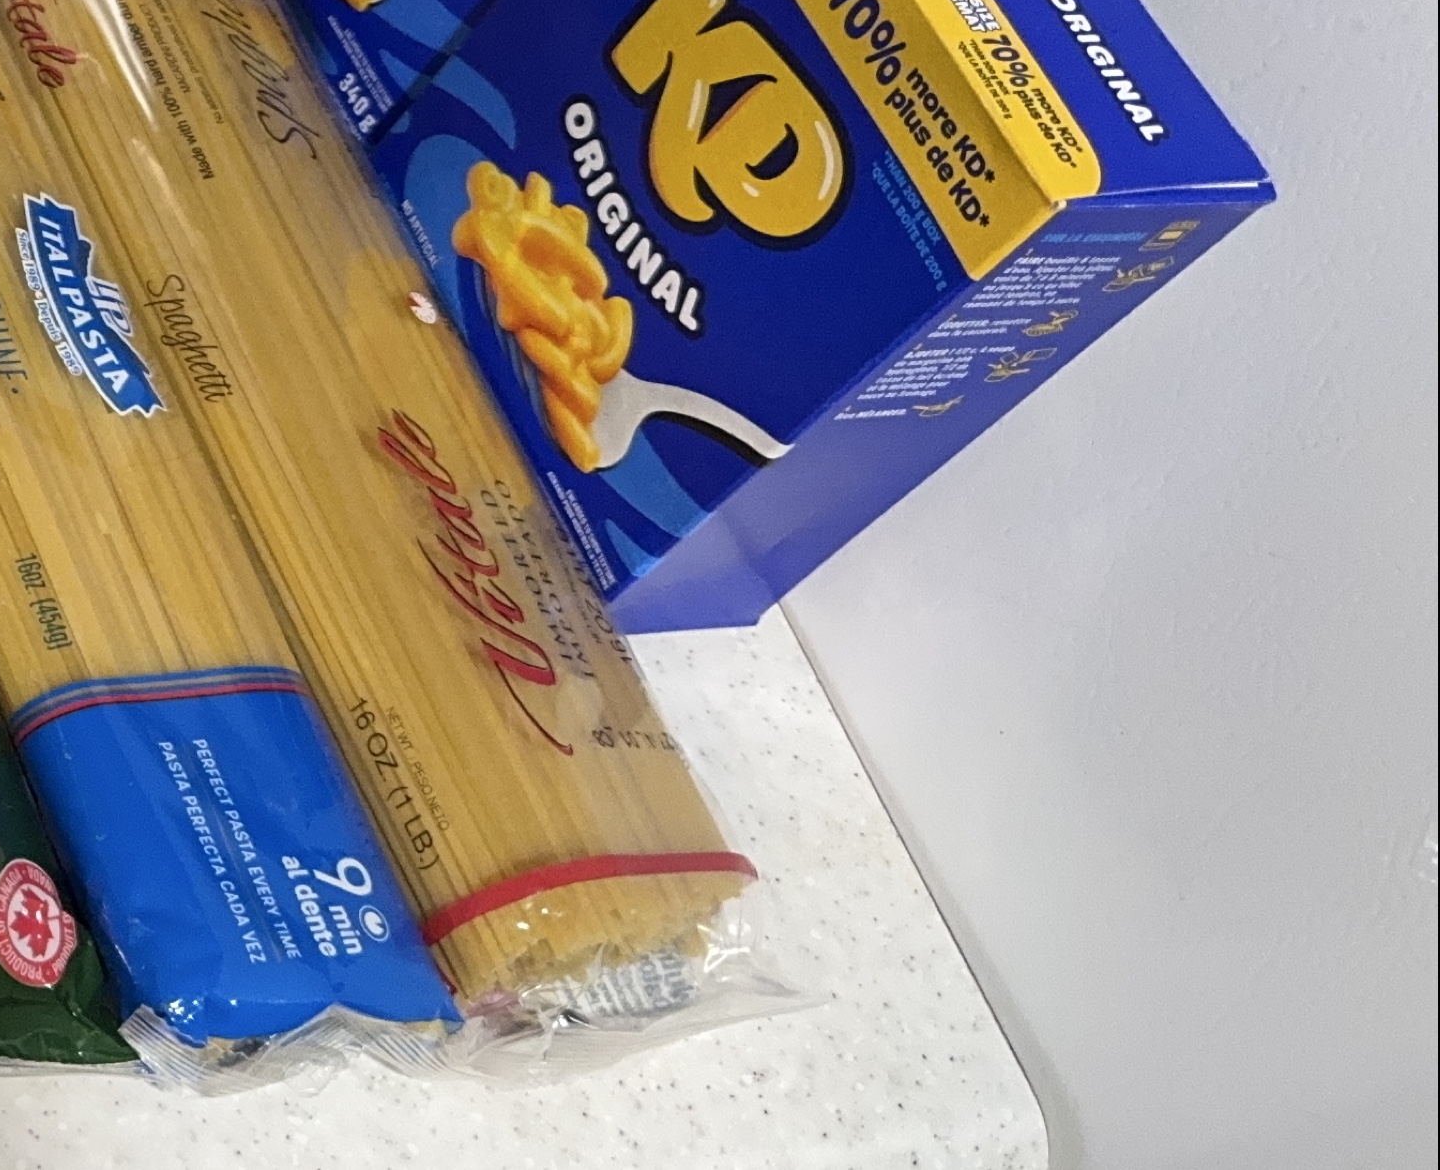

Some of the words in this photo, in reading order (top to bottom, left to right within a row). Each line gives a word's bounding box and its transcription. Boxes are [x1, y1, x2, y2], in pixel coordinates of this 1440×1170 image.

[124, 19, 153, 59] amber
[982, 34, 1035, 88] 70%
[143, 56, 168, 87] hard
[339, 72, 370, 116] 340
[157, 85, 184, 120] 100%
[906, 67, 958, 140] more
[1030, 87, 1061, 126] more
[175, 118, 197, 145] with
[884, 87, 932, 147] plus
[926, 145, 955, 183] de
[188, 142, 216, 181] Made
[564, 100, 701, 332] ORIGINAL
[895, 209, 918, 240] BOÎTE
[922, 221, 942, 246] BOX
[37, 301, 60, 342] Depuis
[38, 216, 131, 393] ITALPASTA
[146, 273, 234, 403] Spaghetti
[377, 409, 574, 756] Vitale
[480, 489, 573, 661] IMPORTED
[30, 596, 75, 652] (454g)
[349, 697, 375, 730] 16
[403, 814, 440, 871] LB.)
[158, 741, 191, 793] PASTA
[182, 795, 227, 877] PERFECTA
[219, 879, 251, 927] CADA
[242, 930, 268, 965] VEZ
[193, 738, 234, 807] PERFECT
[224, 809, 256, 863] PASTA
[248, 865, 282, 918] EVERY
[273, 920, 302, 960] TIME
[281, 854, 310, 880] al
[313, 856, 372, 896] 9
[293, 884, 338, 958] dente
[328, 904, 363, 956] min
